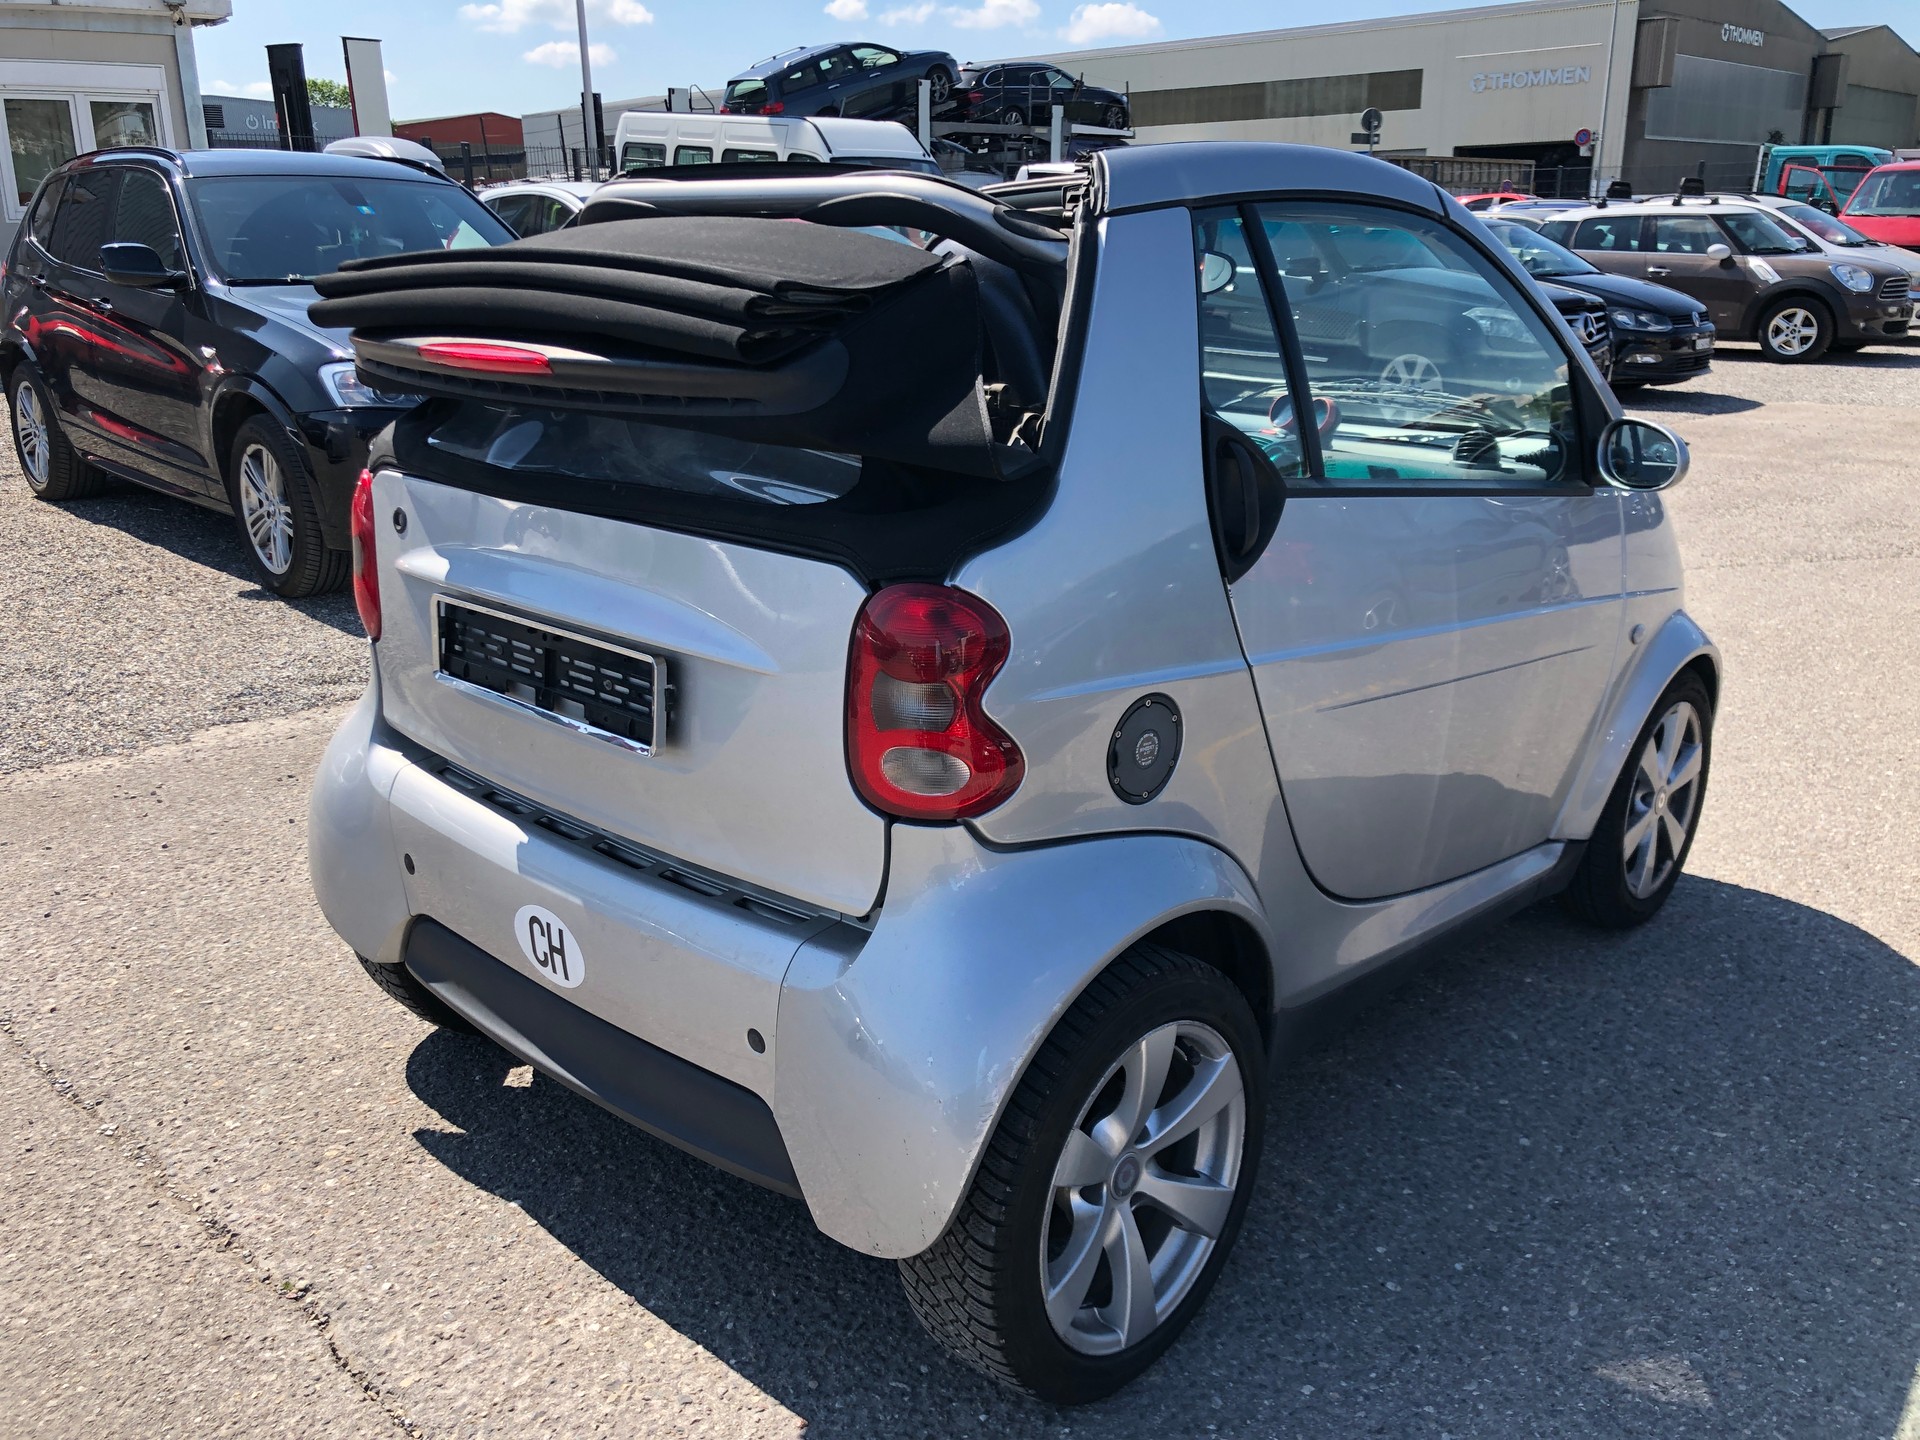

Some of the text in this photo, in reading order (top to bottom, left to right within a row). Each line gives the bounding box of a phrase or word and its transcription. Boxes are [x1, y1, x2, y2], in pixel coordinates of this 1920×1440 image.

[1729, 25, 1764, 46] THOMMEN
[1489, 66, 1591, 89] THOMMEN
[528, 915, 570, 982] CH
